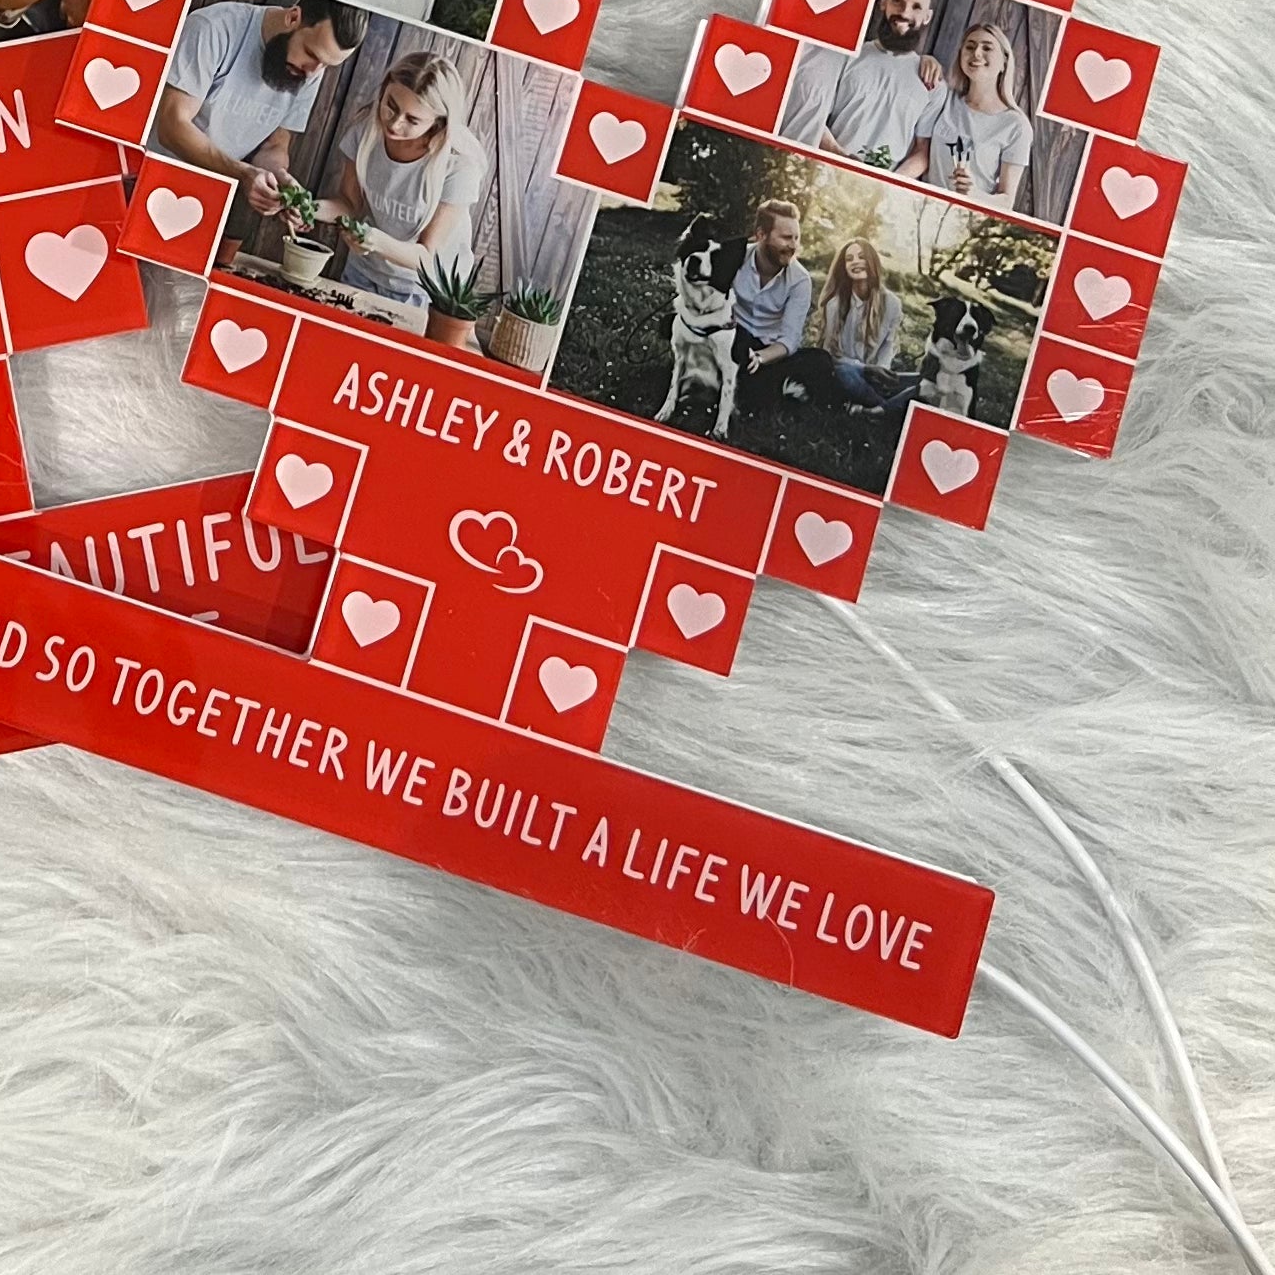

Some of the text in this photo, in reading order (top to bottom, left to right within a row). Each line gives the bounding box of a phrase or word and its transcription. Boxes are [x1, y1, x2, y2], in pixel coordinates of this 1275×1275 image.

[332, 362, 718, 523] ASHLEY & ROBERT
[1, 511, 329, 596] AUTIFUL
[35, 635, 96, 692] SO
[112, 656, 348, 781] TOGETHER
[366, 739, 436, 806] WE
[442, 767, 578, 851] BUILT
[581, 816, 608, 868] A
[622, 828, 728, 903] LIFE
[740, 864, 810, 930] WE
[816, 892, 933, 970] LOVE
